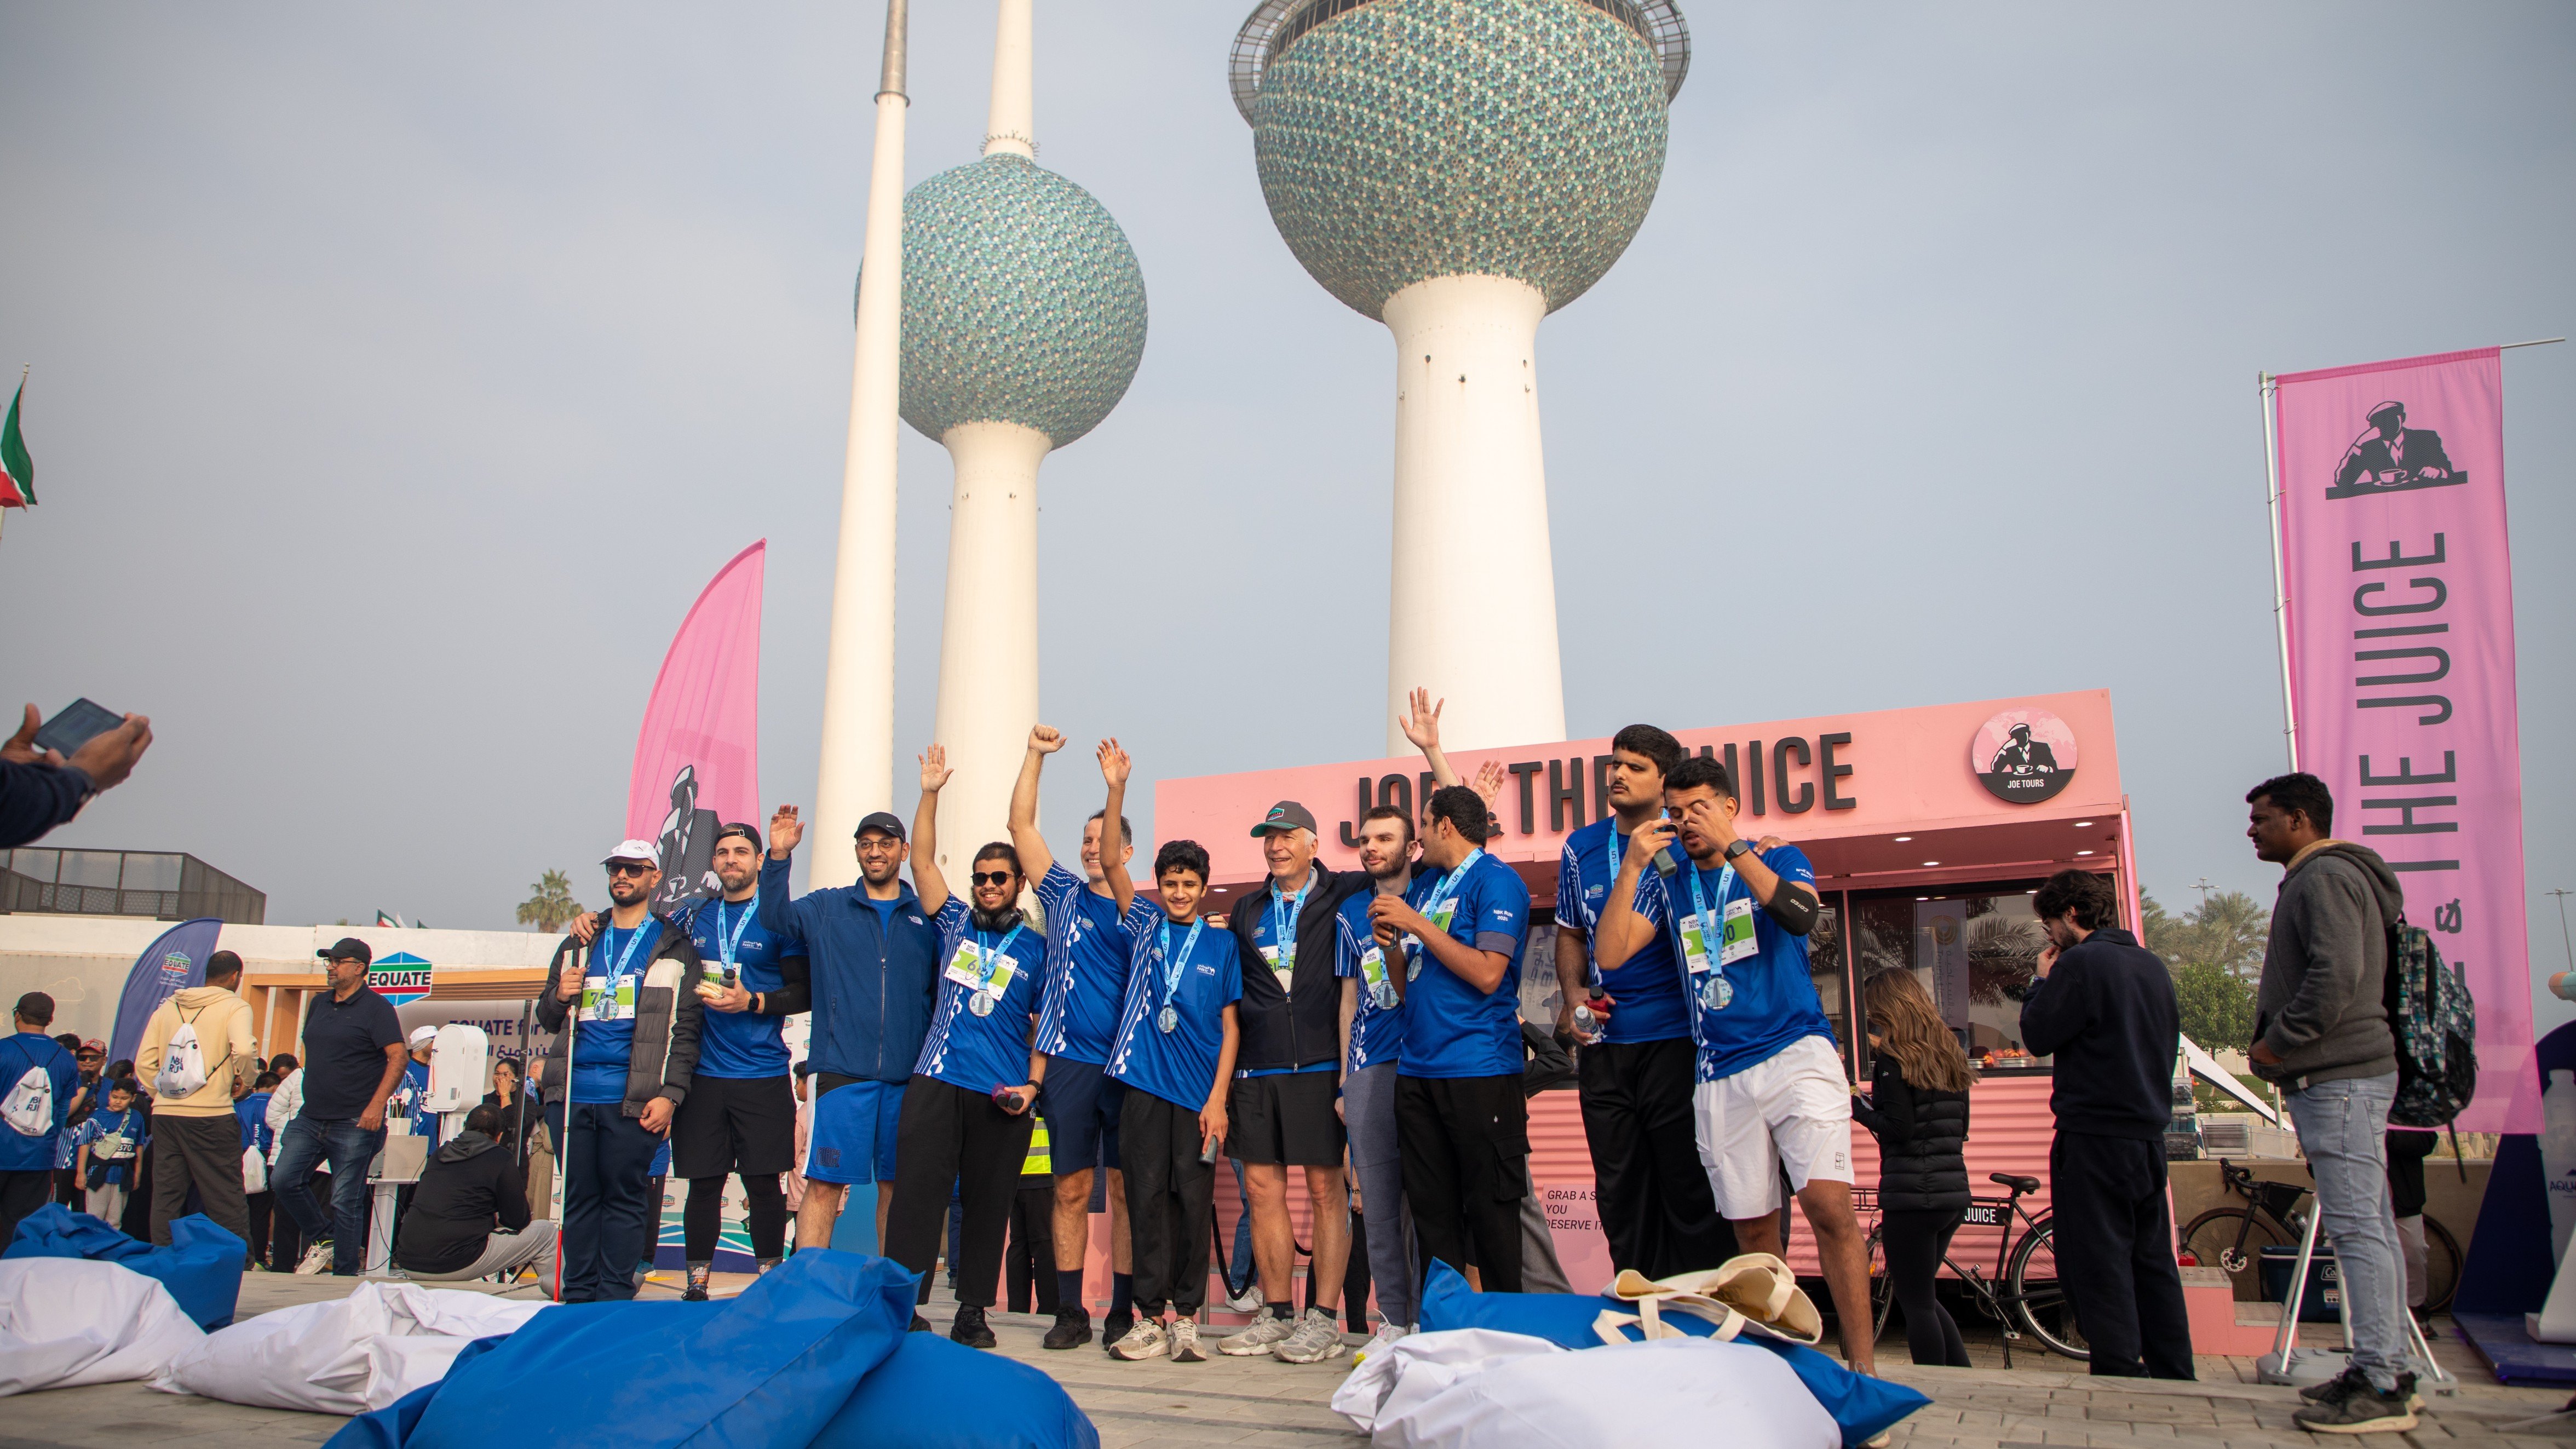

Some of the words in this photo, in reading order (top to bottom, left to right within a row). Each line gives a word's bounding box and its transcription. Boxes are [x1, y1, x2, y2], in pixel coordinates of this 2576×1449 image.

[2350, 532, 2453, 727] JUICE
[2007, 780, 2021, 789] JOE
[2021, 779, 2044, 787] TOURS
[2435, 899, 2462, 934] &
[164, 959, 189, 970] EQUATE
[368, 971, 432, 986] EQUATE
[2549, 1180, 2576, 1193] AQU
[1548, 1190, 1576, 1200] GRAB
[1579, 1191, 1586, 1200] A
[1546, 1204, 1567, 1214] YOU
[1964, 1208, 1997, 1223] JUICE
